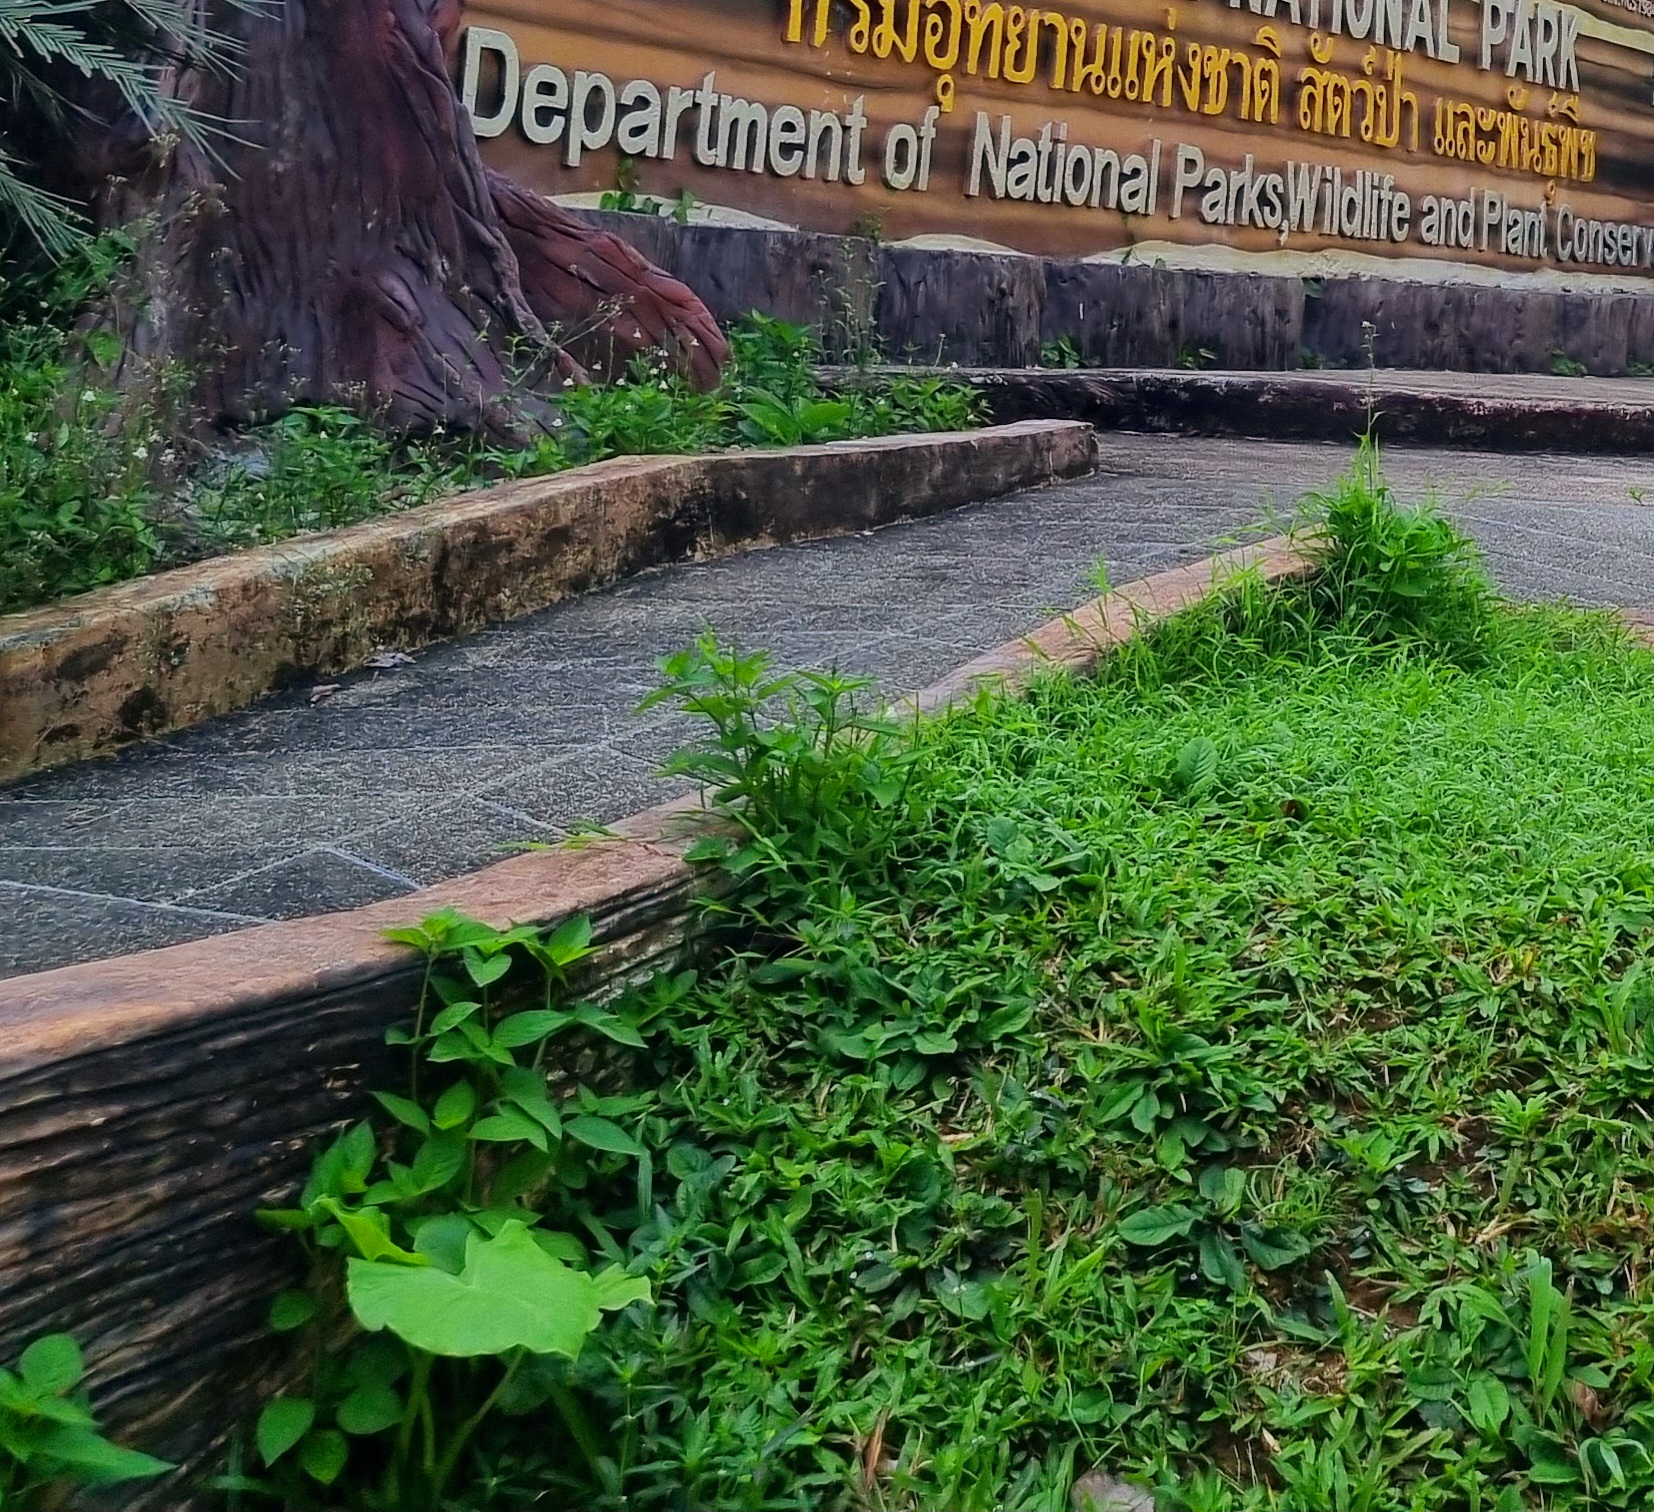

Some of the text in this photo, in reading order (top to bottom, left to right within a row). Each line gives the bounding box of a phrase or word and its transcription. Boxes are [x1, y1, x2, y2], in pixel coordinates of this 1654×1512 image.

[463, 25, 868, 168] Department
[882, 104, 941, 192] of
[964, 110, 1163, 217] National
[1420, 187, 1477, 249] and
[1478, 188, 1549, 259] Plant
[1297, 31, 1420, 153] สัตว์ป่า
